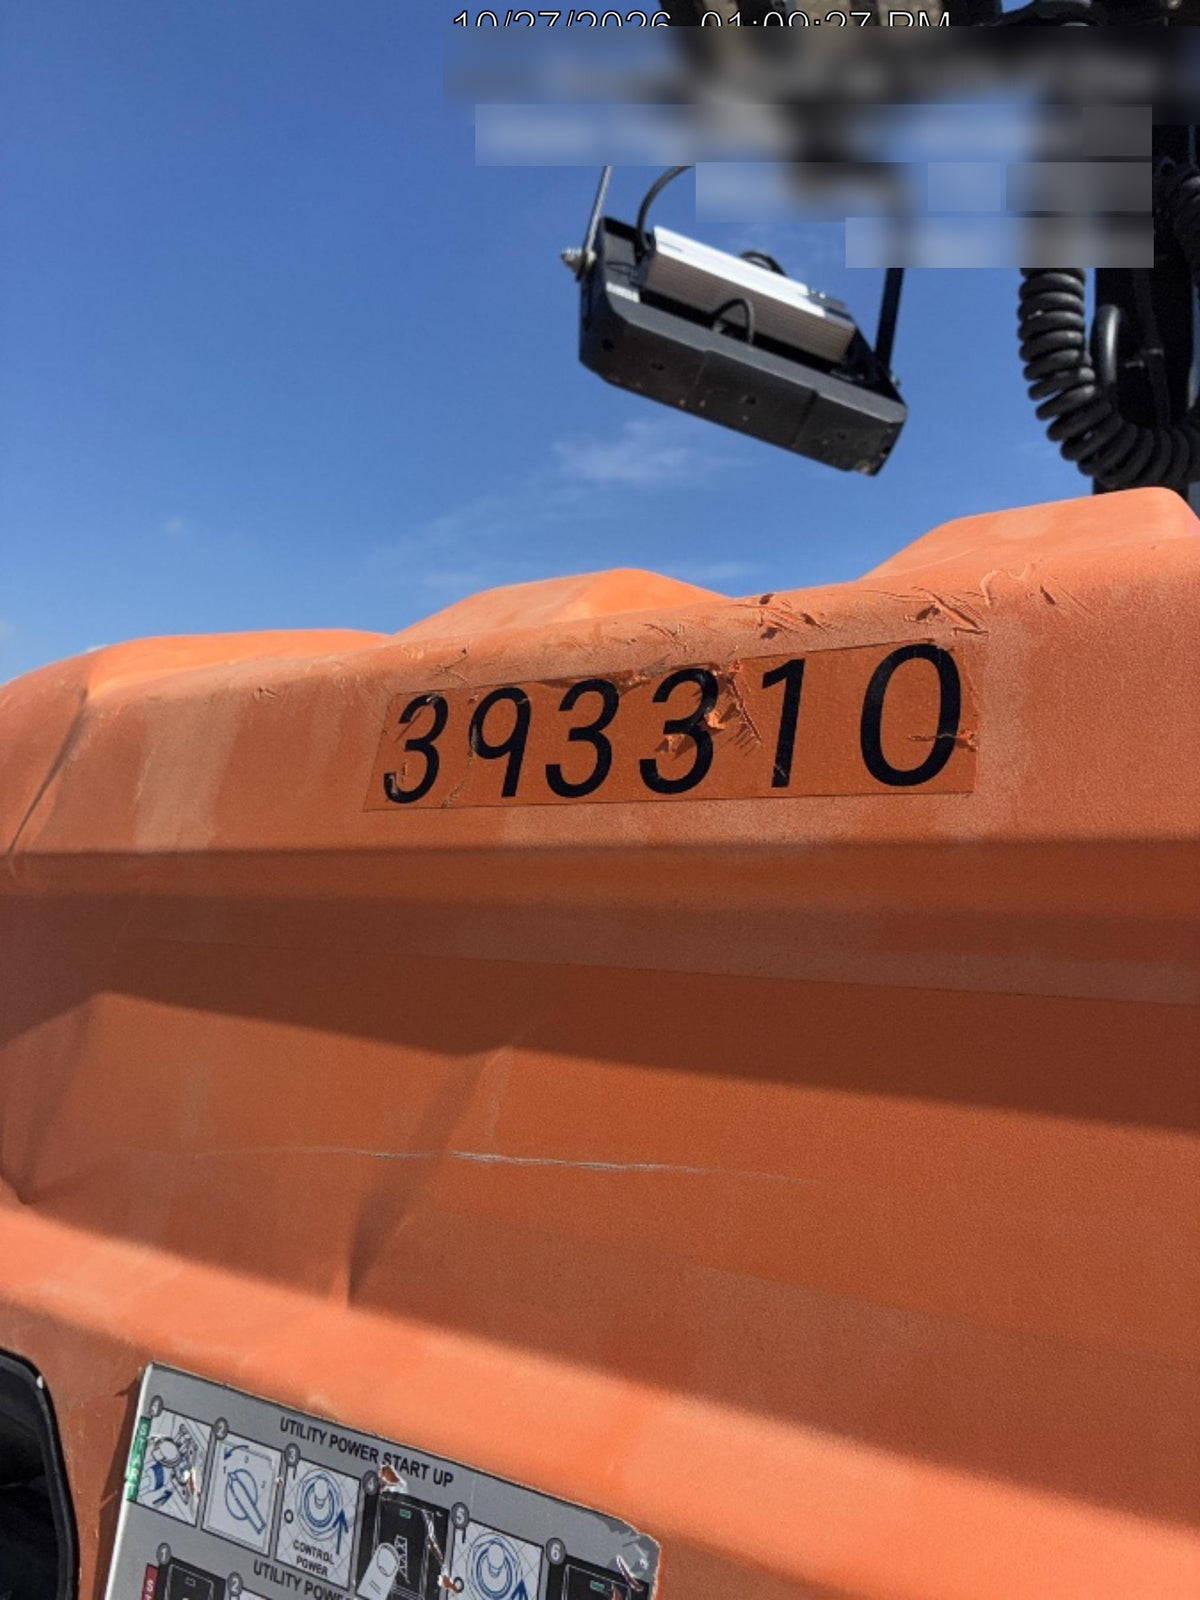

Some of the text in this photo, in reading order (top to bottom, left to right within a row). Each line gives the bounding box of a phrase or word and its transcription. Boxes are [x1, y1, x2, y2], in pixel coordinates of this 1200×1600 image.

[383, 642, 963, 804] 393310
[279, 1415, 455, 1488] UTILITY POWER START UP
[293, 1540, 334, 1565] CONTROL
[296, 1555, 328, 1577] POWER
[253, 1559, 351, 1600] UTILITY POW
